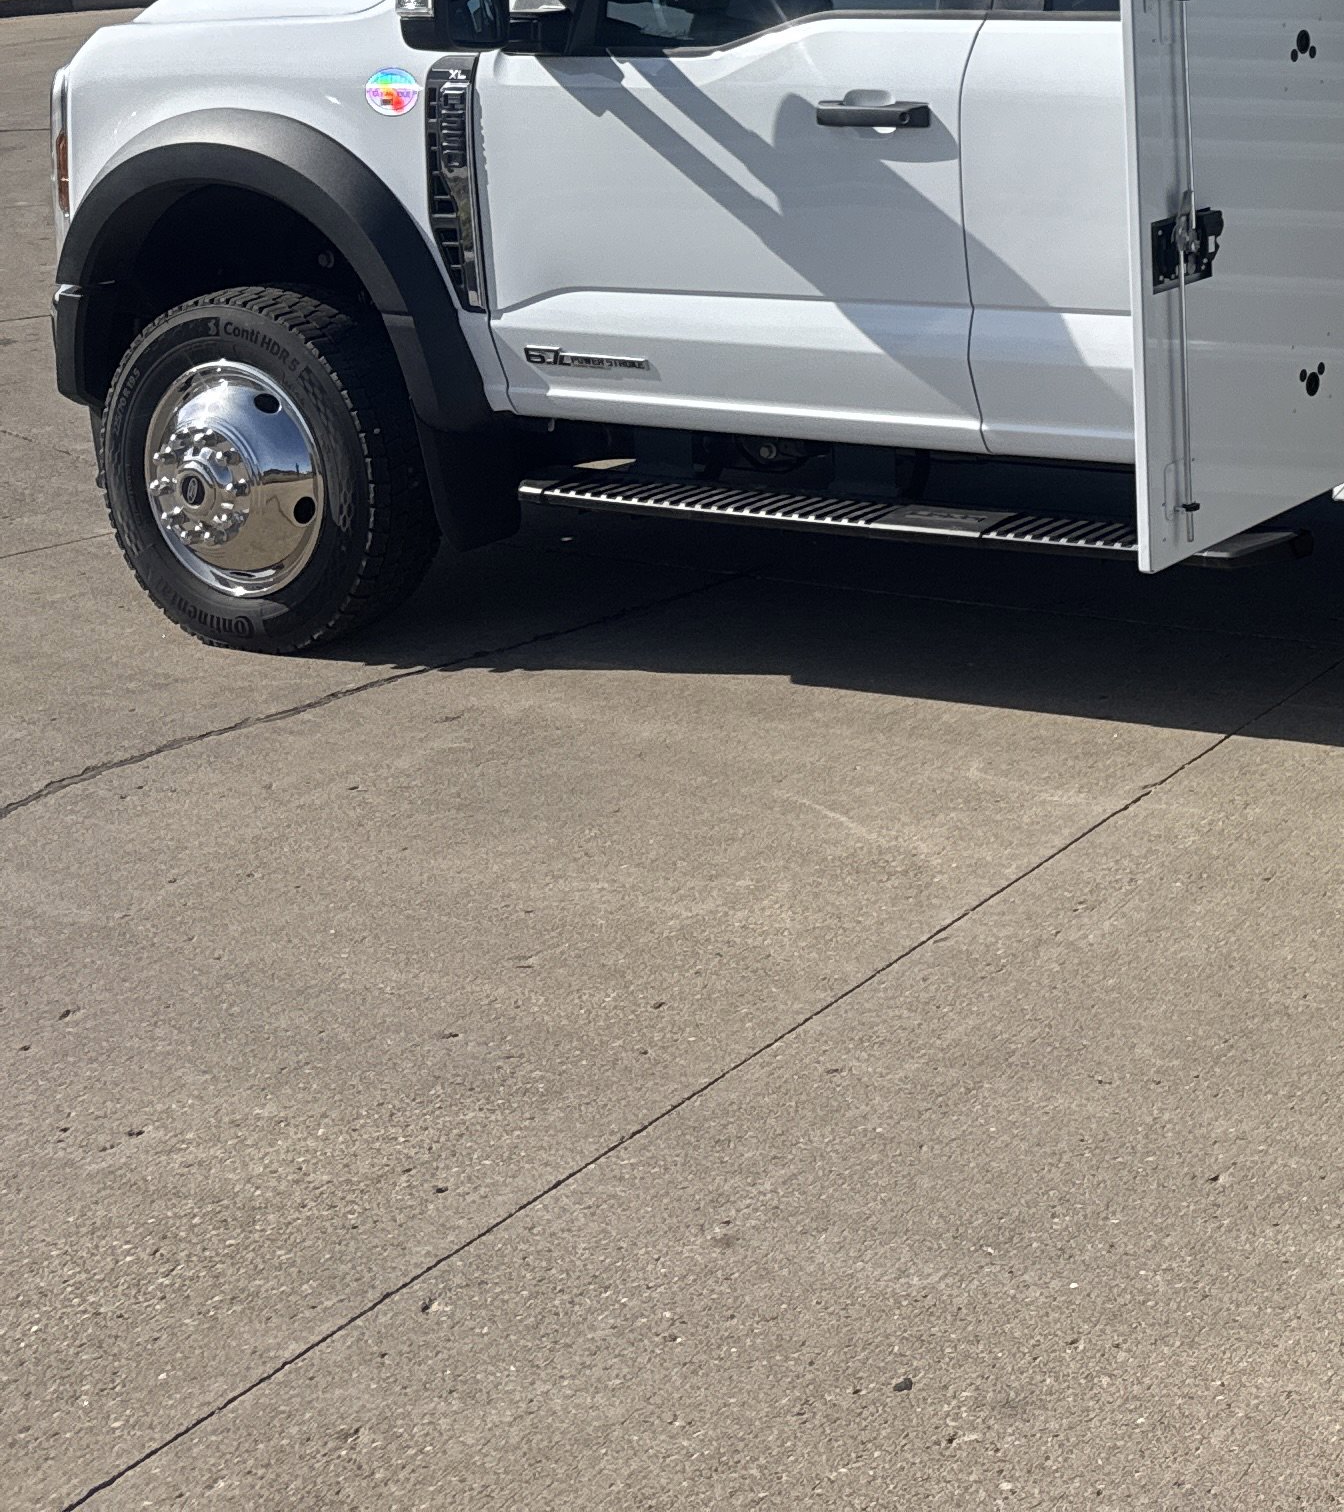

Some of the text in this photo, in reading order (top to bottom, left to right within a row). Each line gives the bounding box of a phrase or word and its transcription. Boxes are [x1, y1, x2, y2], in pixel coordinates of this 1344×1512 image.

[448, 69, 466, 80] XL
[223, 321, 260, 345] Conti
[260, 334, 290, 365] HDR
